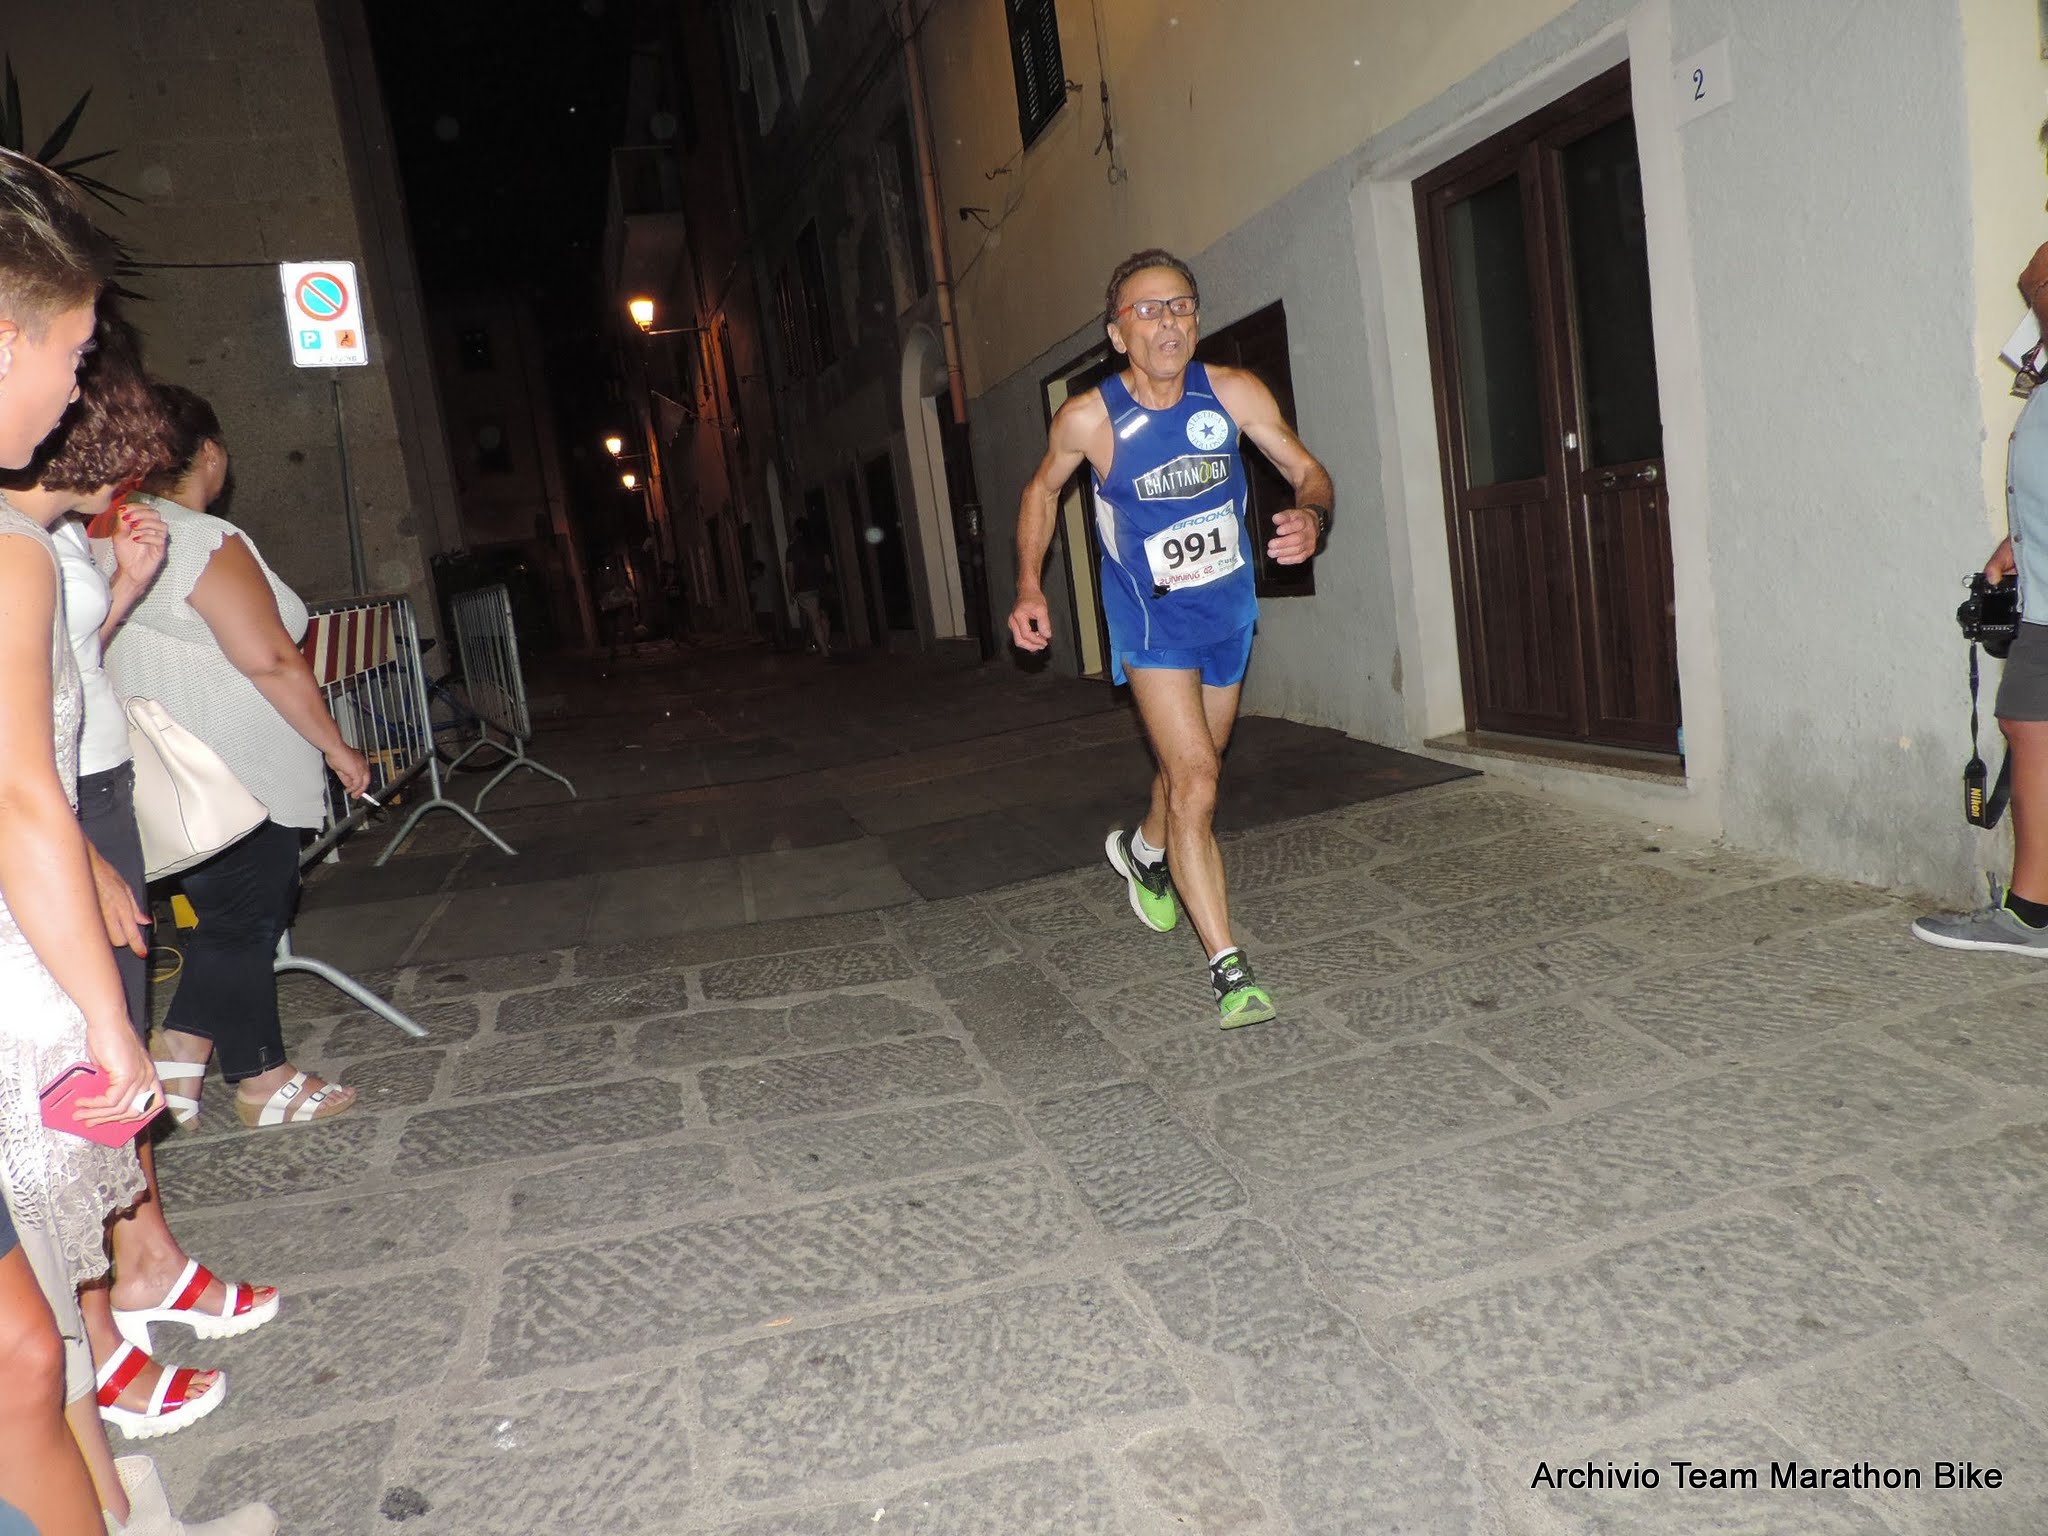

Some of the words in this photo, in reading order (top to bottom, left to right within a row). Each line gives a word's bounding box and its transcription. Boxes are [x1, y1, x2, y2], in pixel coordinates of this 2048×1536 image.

[1692, 68, 1706, 101] 2
[303, 331, 318, 348] P
[1144, 459, 1227, 496] CHATTANOOGA
[1172, 504, 1233, 531] BROOKS
[1163, 527, 1226, 570] 991
[1970, 787, 1982, 818] Nikon
